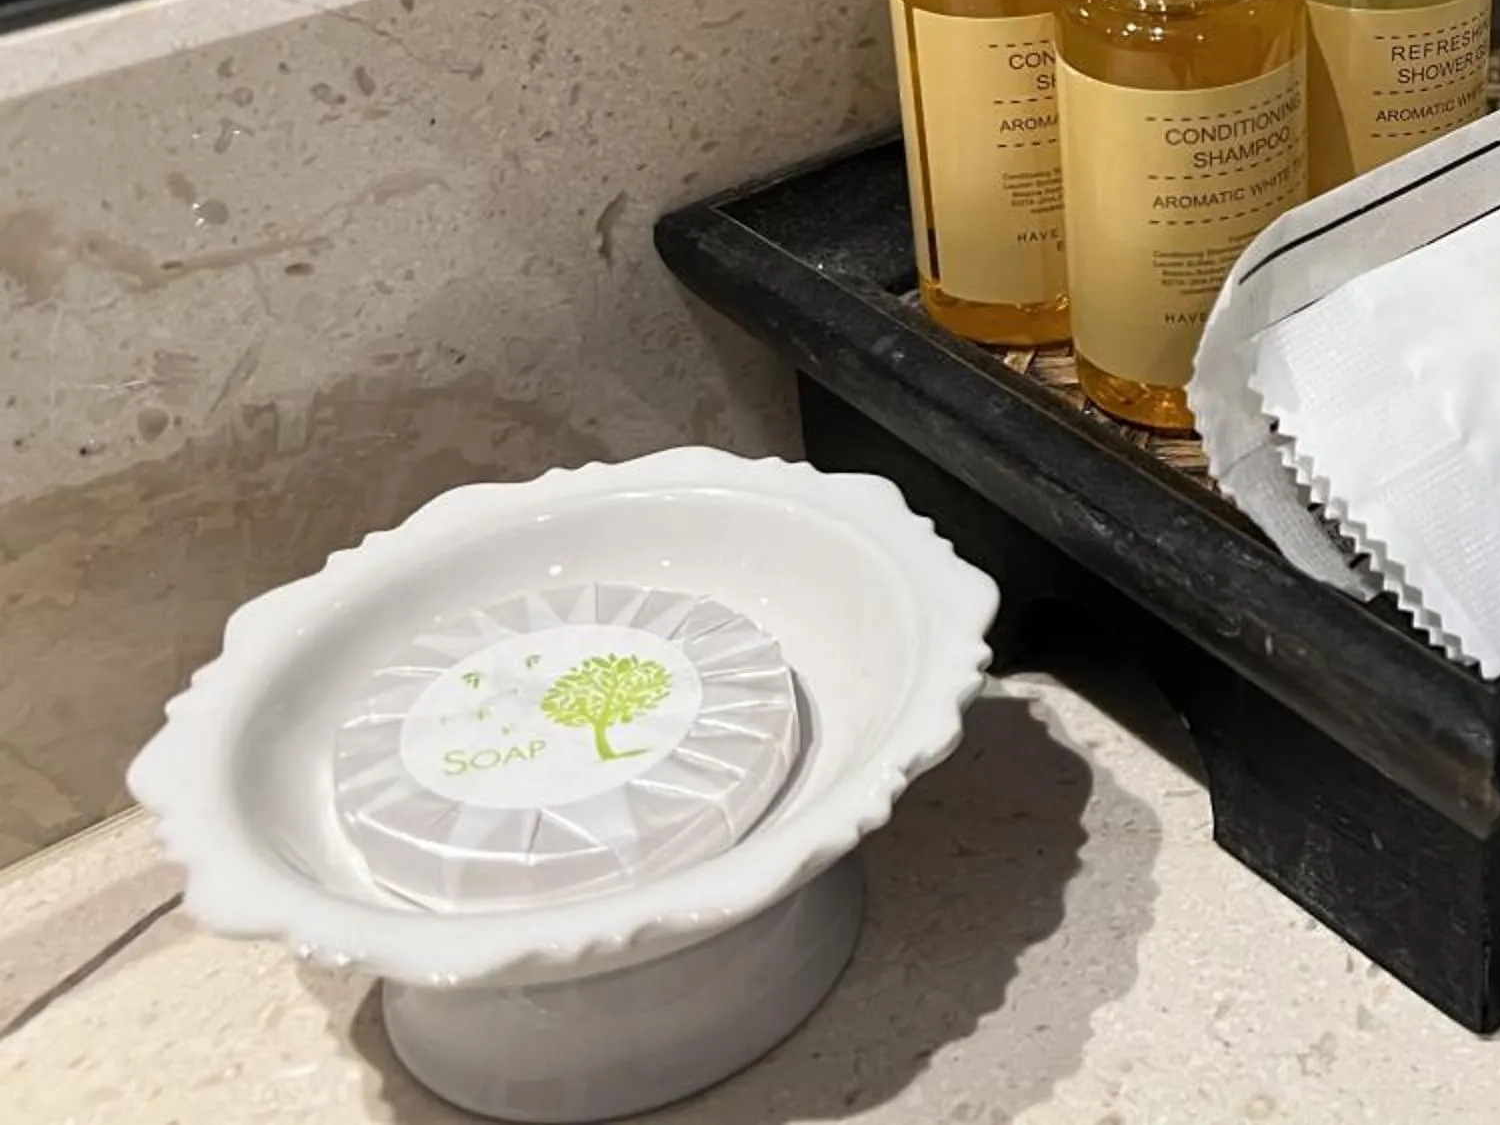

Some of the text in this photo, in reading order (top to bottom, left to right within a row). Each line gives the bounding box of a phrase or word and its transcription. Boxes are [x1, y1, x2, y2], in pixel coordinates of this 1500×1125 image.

[1397, 51, 1473, 84] SHOWER
[1000, 113, 1058, 133] AROM
[1165, 91, 1301, 146] CONDITIONING
[1375, 98, 1455, 123] AROMATIC
[1193, 125, 1290, 169] SHAMPOO
[1152, 187, 1245, 209] AROMATIC
[441, 739, 547, 776] SOAP
